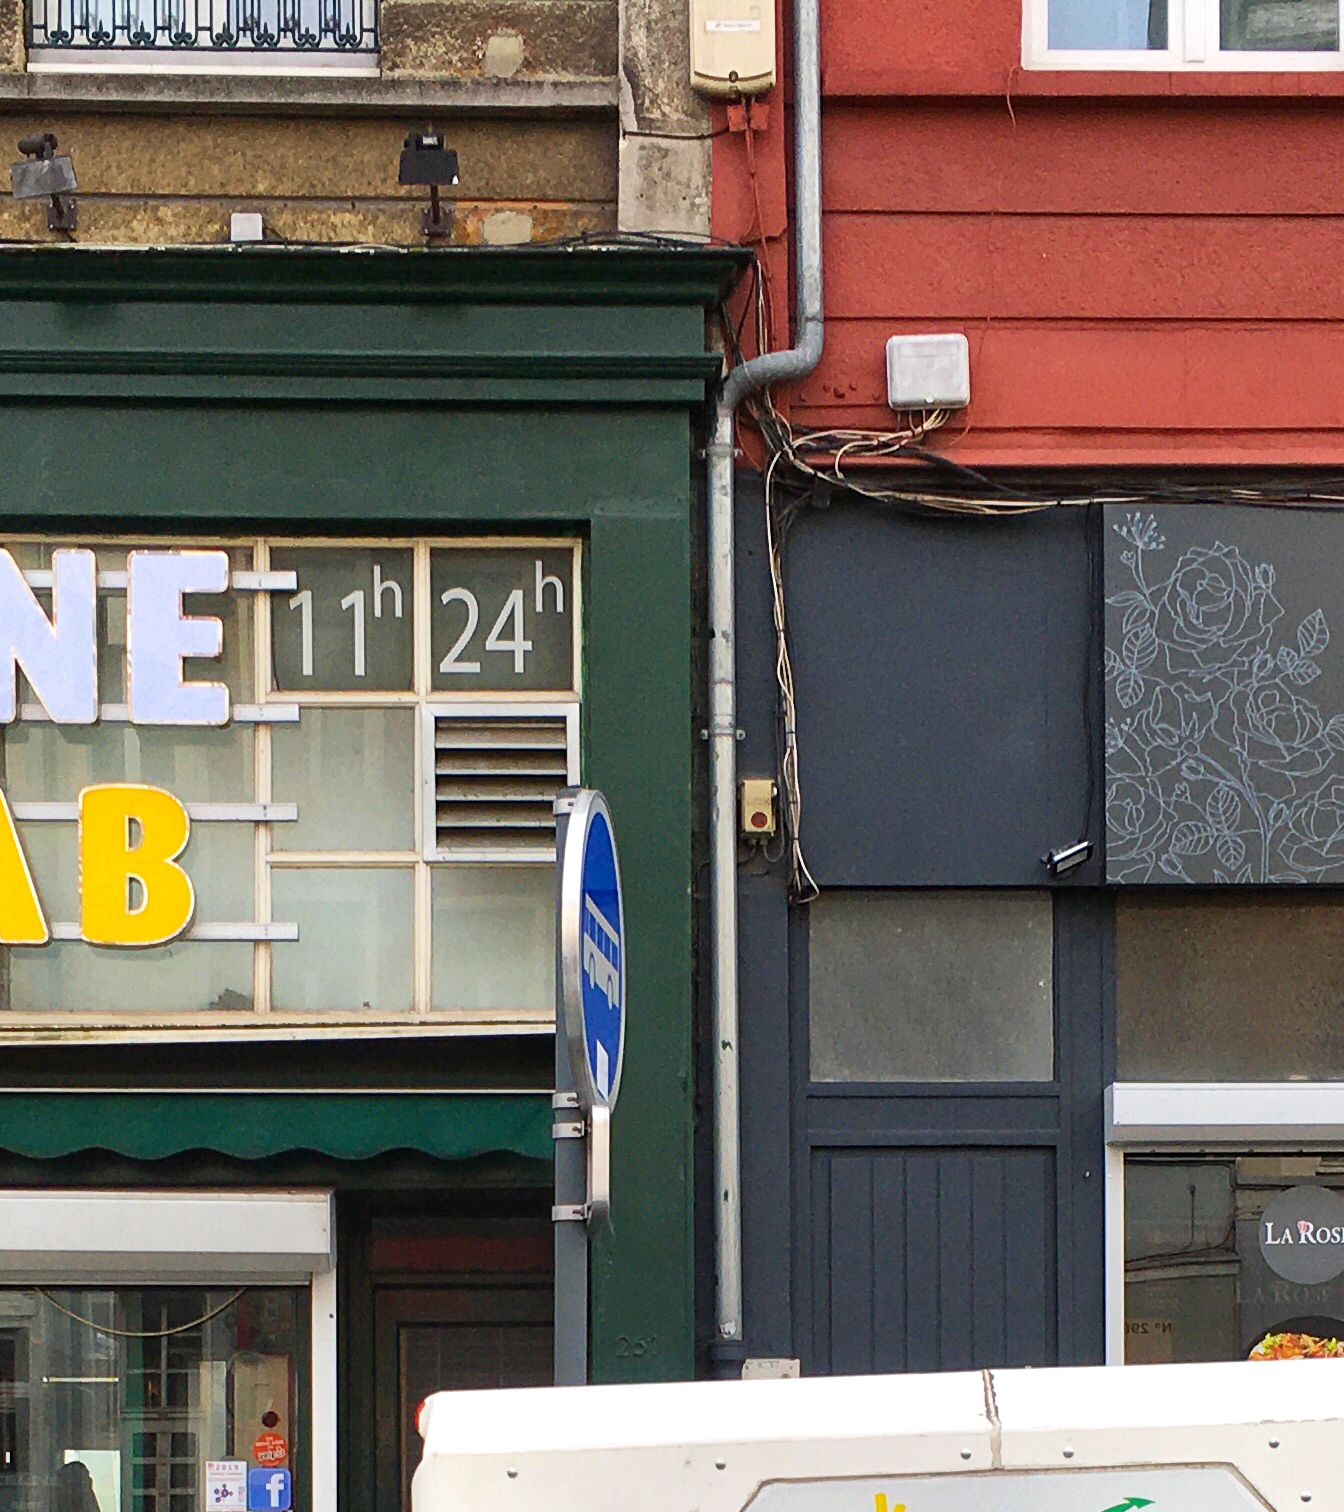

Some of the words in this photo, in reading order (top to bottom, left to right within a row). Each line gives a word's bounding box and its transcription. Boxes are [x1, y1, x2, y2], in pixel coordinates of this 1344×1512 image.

[289, 565, 402, 677] 11h
[439, 561, 564, 675] 24h
[1265, 1222, 1294, 1245] LA
